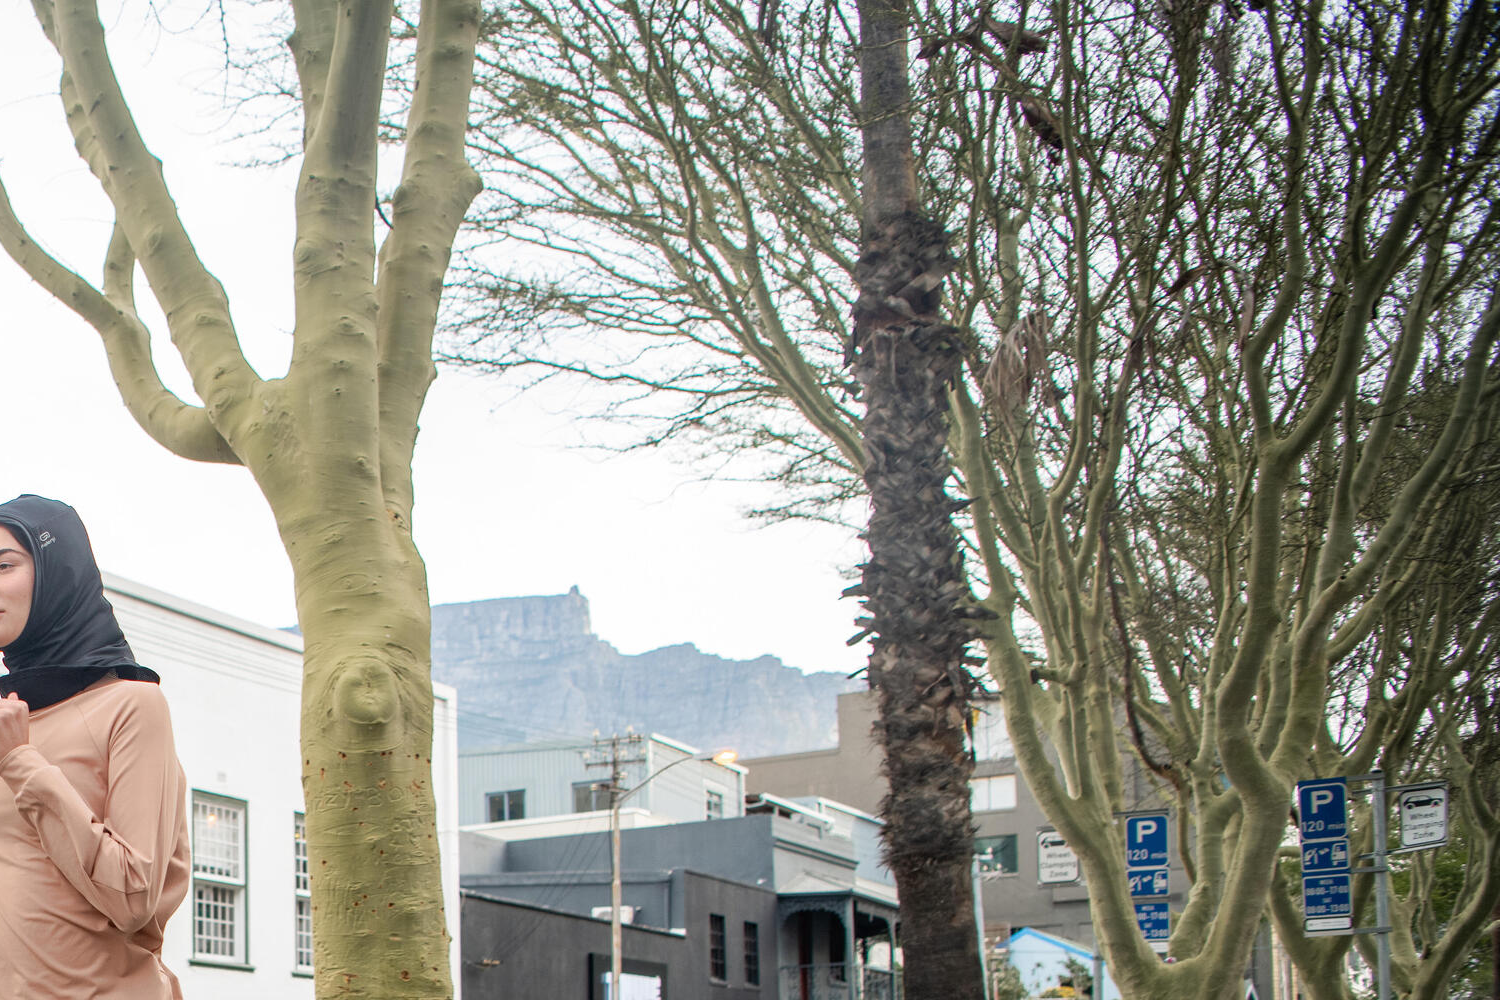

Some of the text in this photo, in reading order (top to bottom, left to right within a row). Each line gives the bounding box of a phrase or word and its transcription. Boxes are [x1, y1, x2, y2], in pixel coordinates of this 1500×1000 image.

[1311, 789, 1334, 814] P
[1136, 820, 1158, 843] P
[1301, 820, 1346, 833] 120 min
[1127, 848, 1149, 861] 120
